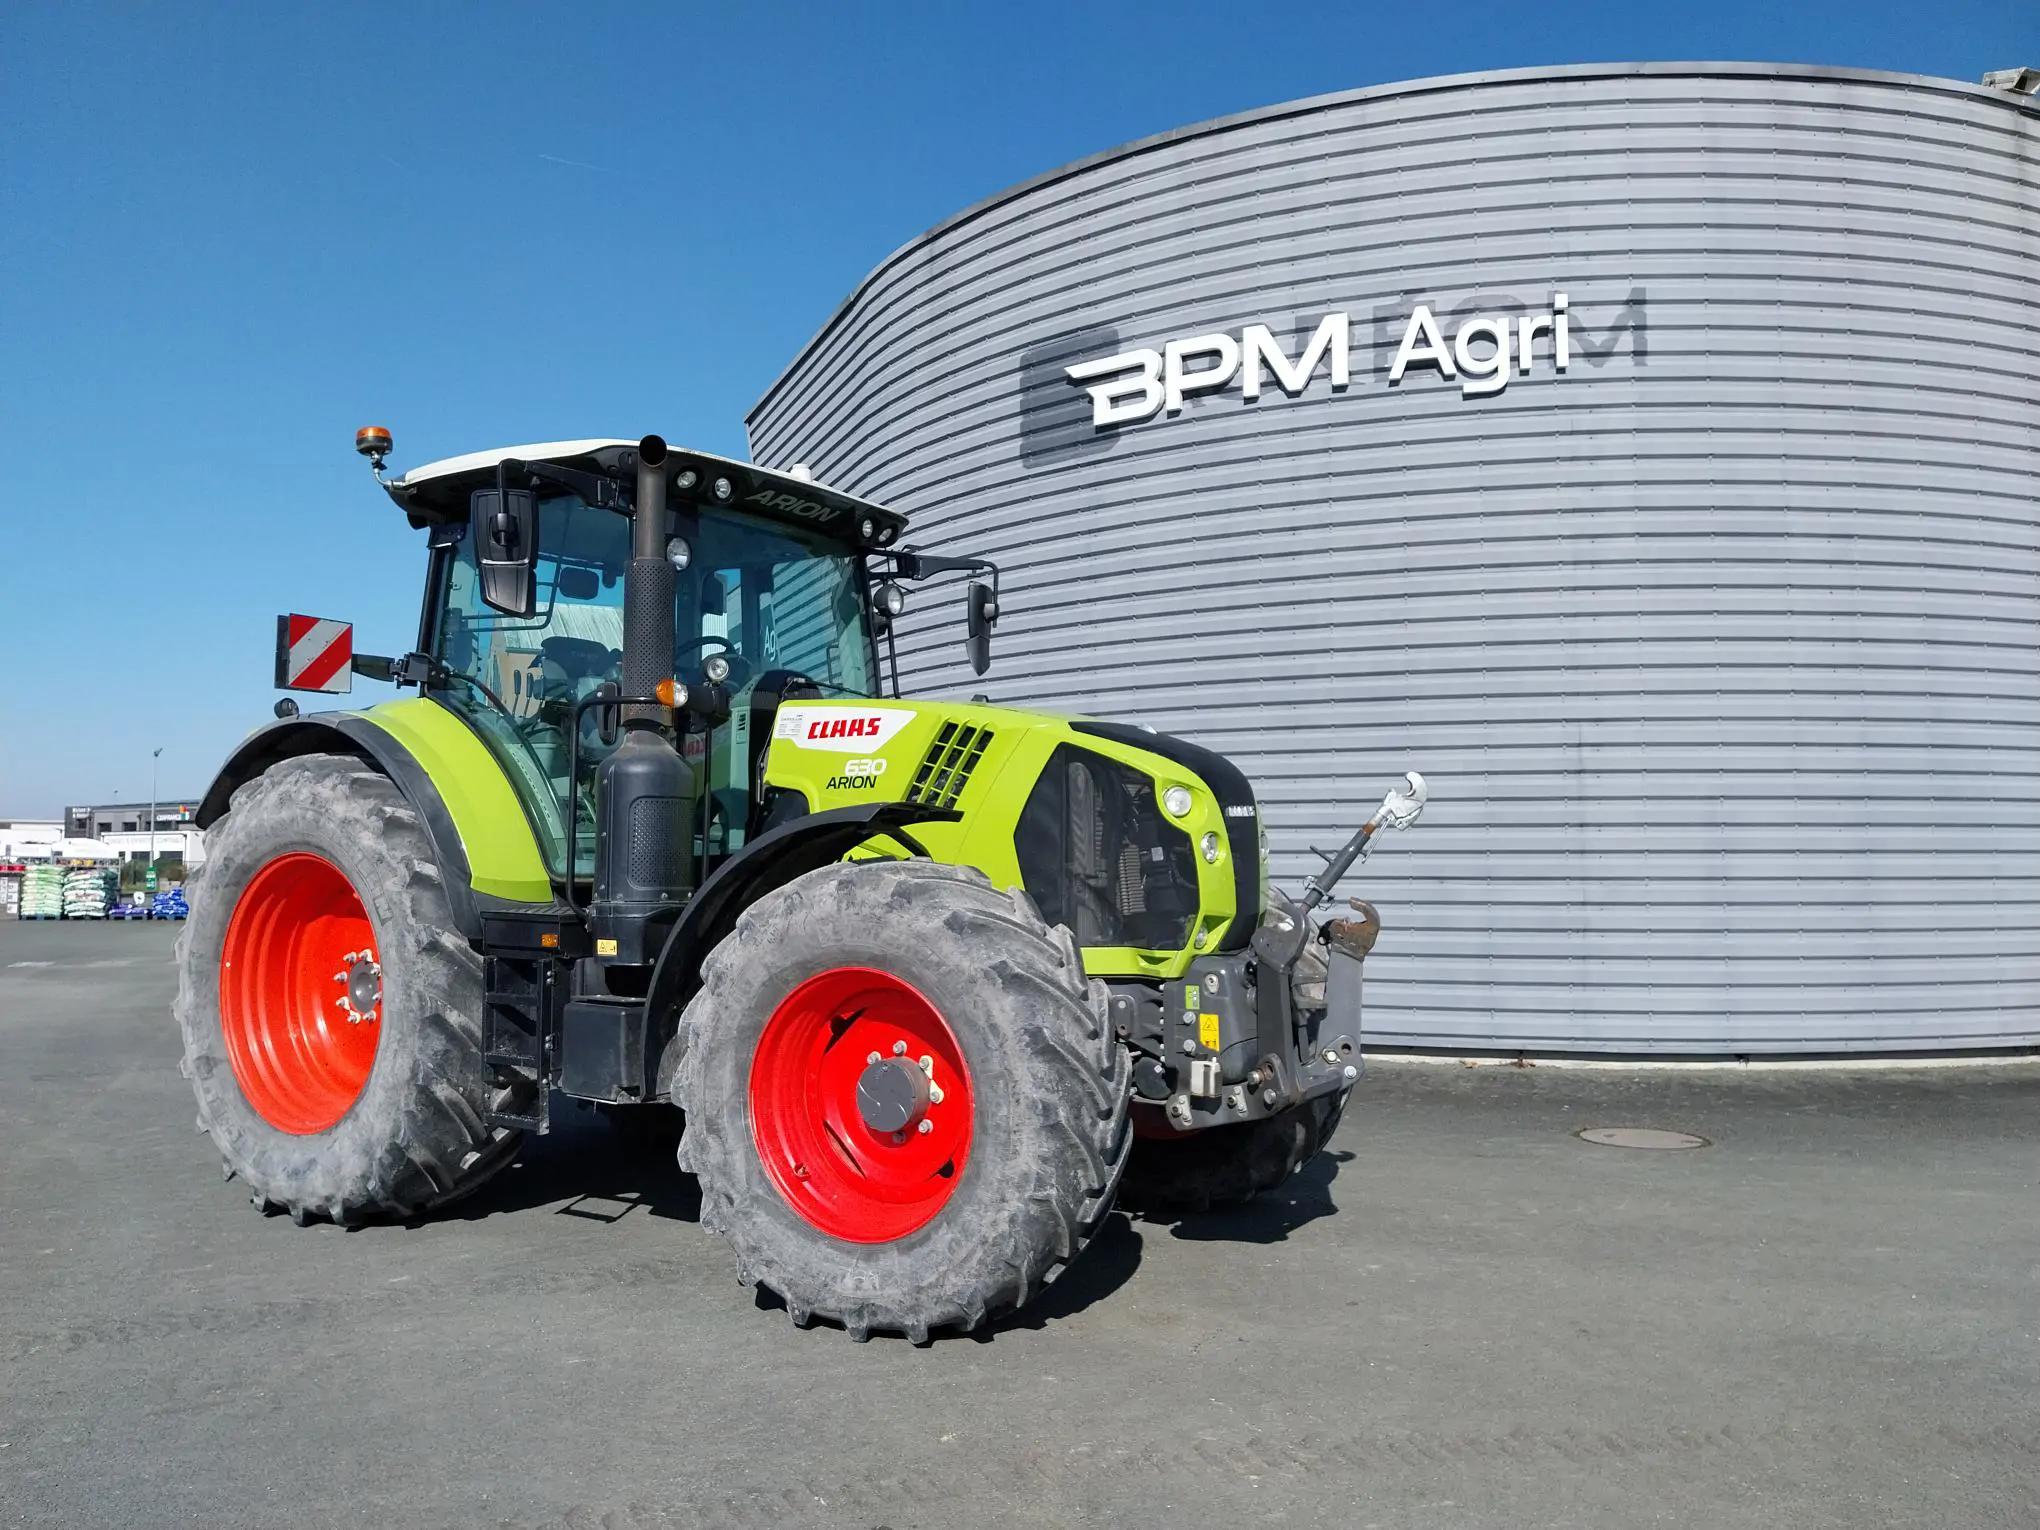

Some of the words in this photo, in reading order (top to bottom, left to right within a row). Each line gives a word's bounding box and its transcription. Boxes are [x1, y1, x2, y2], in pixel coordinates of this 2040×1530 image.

[1064, 312, 1350, 428] BPM
[1388, 293, 1570, 400] Agri
[745, 489, 841, 522] ARION
[807, 717, 882, 740] CLAAS
[845, 758, 888, 777] 630
[826, 775, 877, 790] ARION
